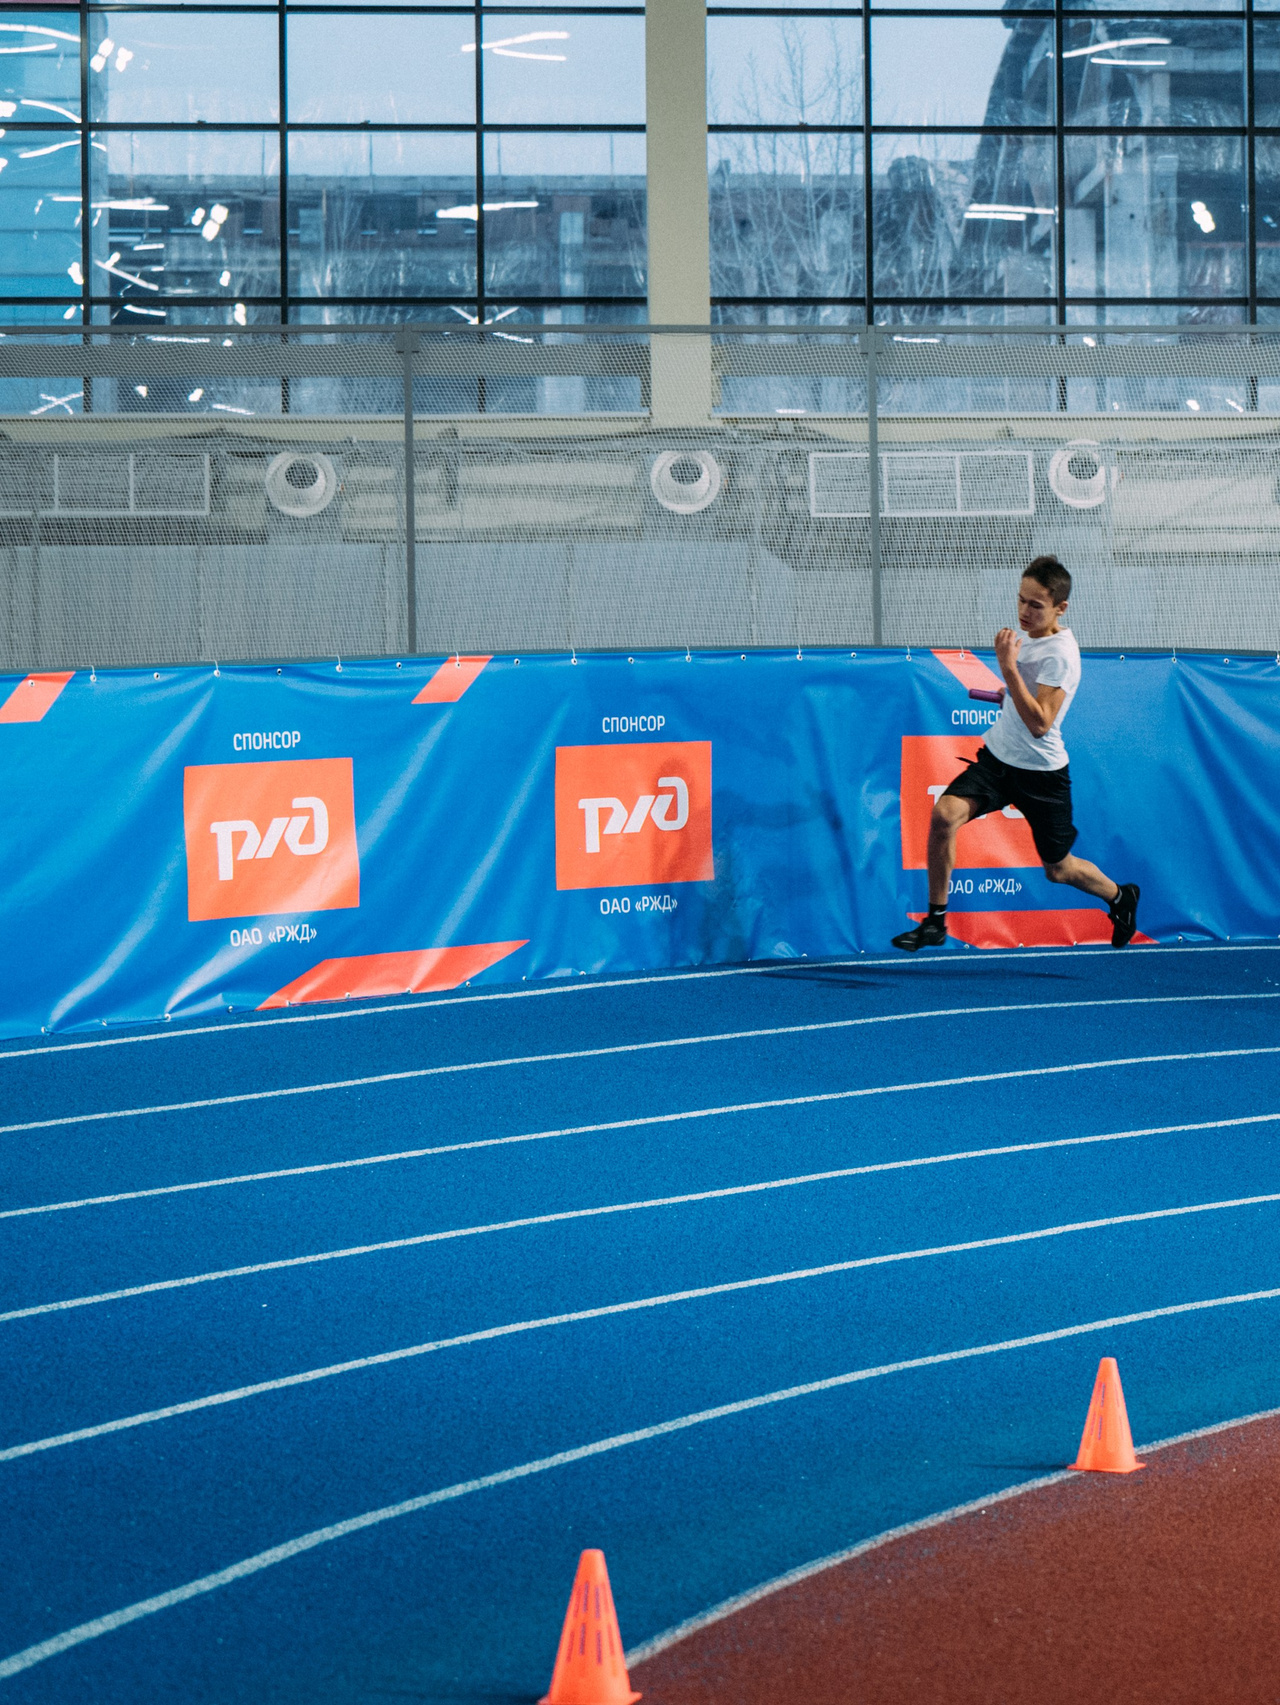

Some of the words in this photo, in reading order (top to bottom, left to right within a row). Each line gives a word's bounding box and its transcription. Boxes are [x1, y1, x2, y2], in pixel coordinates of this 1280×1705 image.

[602, 715, 666, 733] СПОНСОР
[951, 709, 1003, 726] СПОНС
[233, 730, 301, 751] СПОНСОР
[978, 878, 1023, 895] «РЖД»
[600, 898, 631, 915] ОАО
[635, 895, 679, 914] «РЖД»
[230, 928, 263, 947] ОАО
[268, 924, 318, 944] «РЖД»
